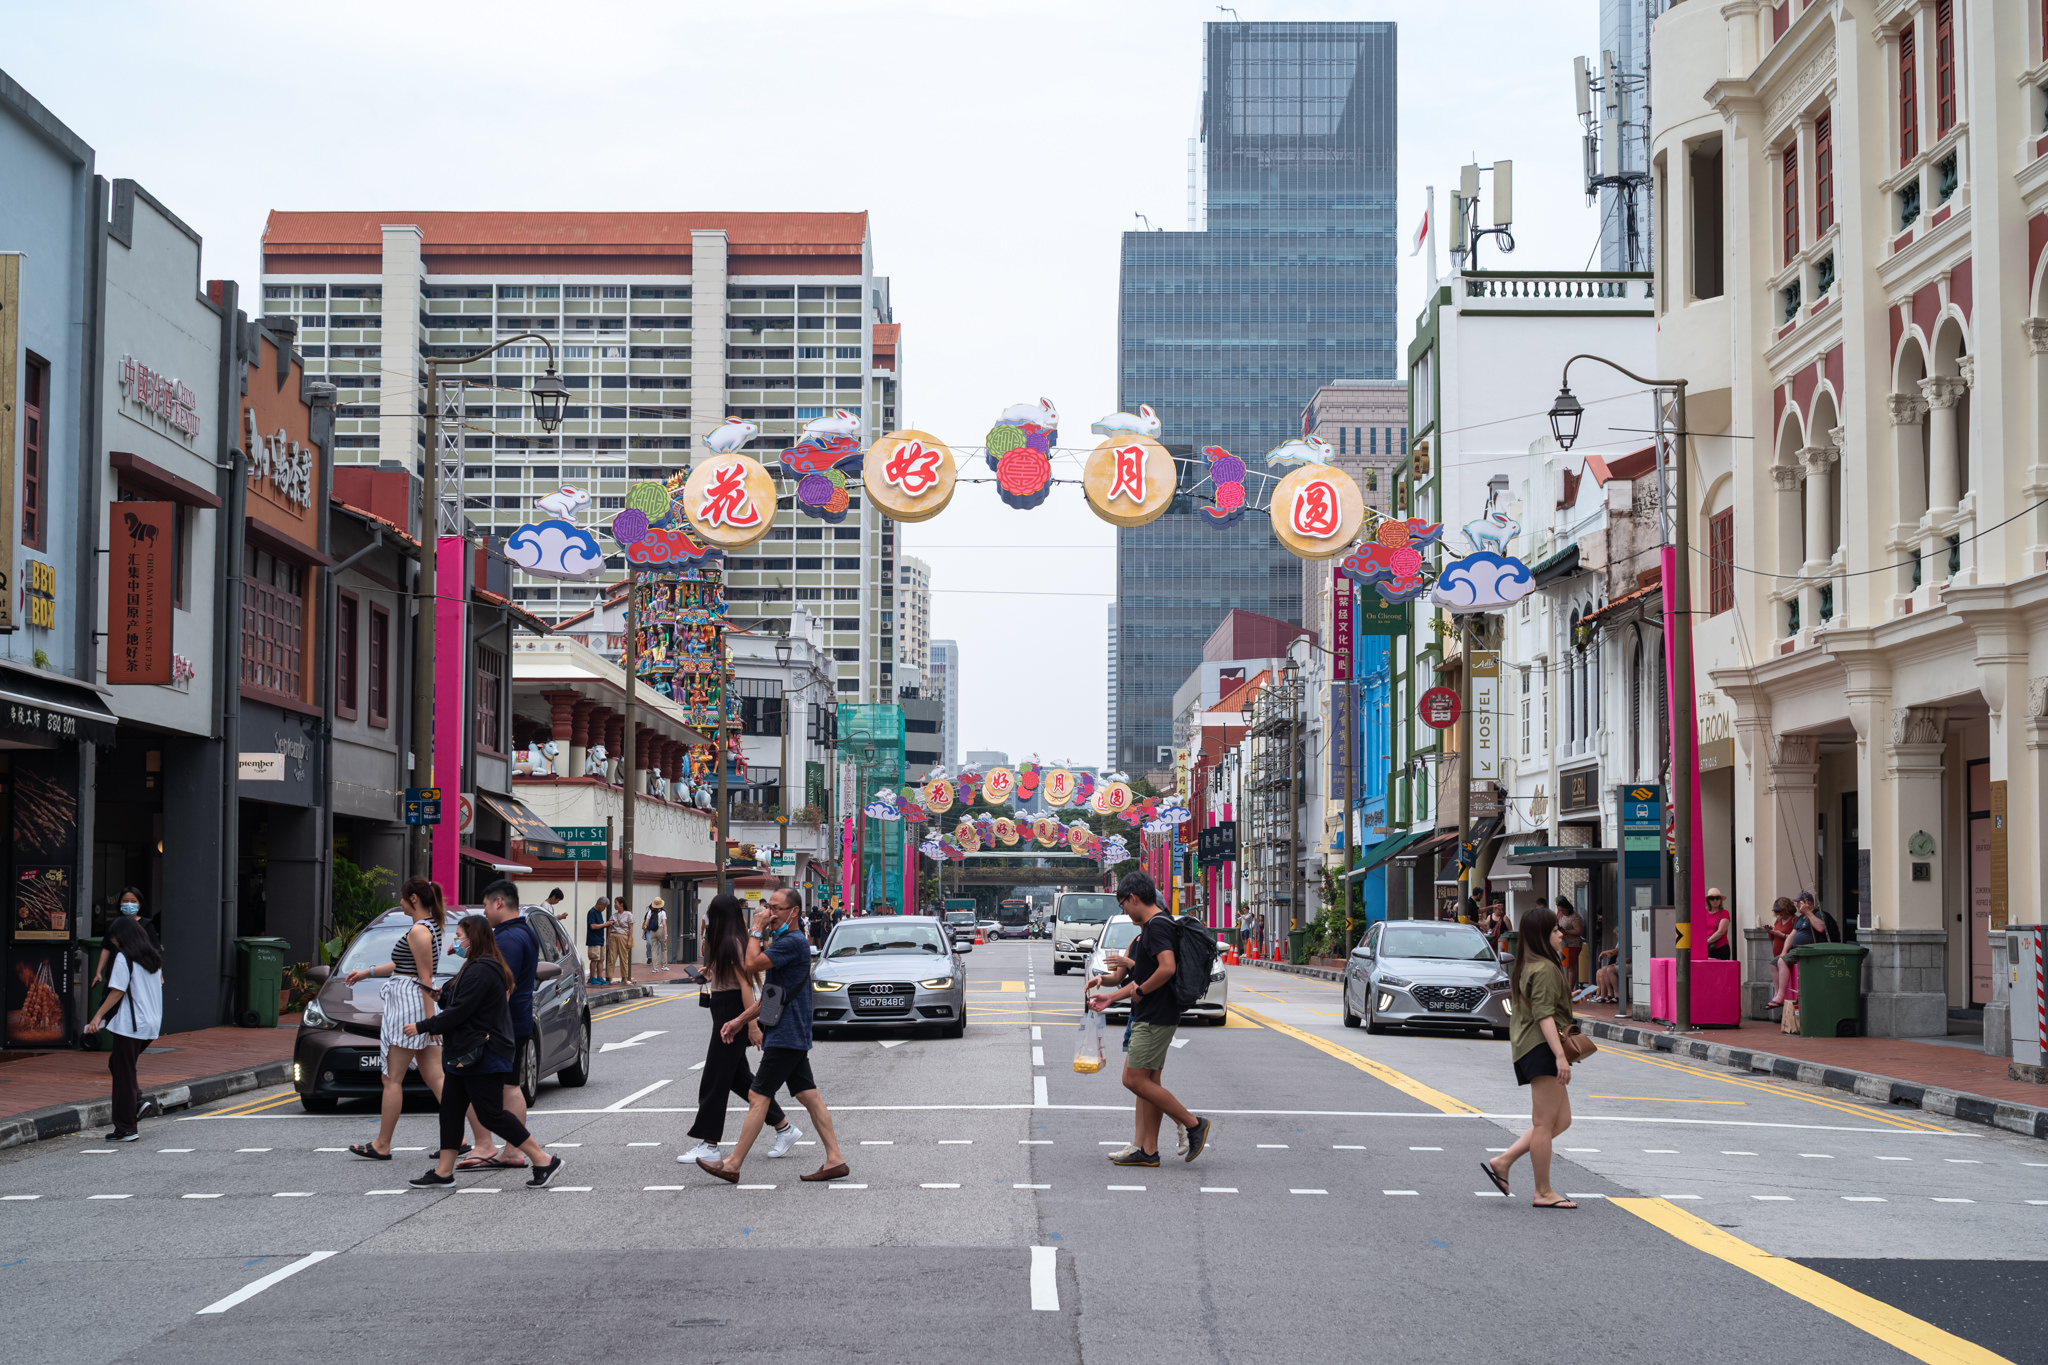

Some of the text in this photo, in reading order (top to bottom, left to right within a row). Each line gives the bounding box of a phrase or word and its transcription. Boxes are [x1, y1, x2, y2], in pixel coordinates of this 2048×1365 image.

[124, 356, 173, 420] 中國汾酒
[177, 379, 196, 409] CHINA
[175, 401, 201, 437] FENJIU
[700, 462, 760, 527] 花
[885, 441, 941, 495] 好
[1110, 446, 1147, 503] 月
[32, 560, 55, 600] BBQ
[146, 552, 154, 581] CHINA
[146, 582, 154, 607] BAMA
[32, 596, 55, 630] BOX
[126, 552, 140, 672] 汇集中国原产地好茶
[145, 608, 153, 626] TEA
[1377, 612, 1402, 621] Cheong
[145, 627, 153, 652] SINCE
[1428, 693, 1453, 723] 當
[1479, 689, 1490, 749] HOSTEL
[1706, 711, 1729, 744] ROOM
[239, 760, 275, 769] ptember
[930, 782, 949, 803] 花
[992, 771, 1010, 790] 好
[1053, 772, 1065, 793] 月
[557, 828, 603, 840] mple St
[567, 848, 591, 858] 婆街
[1829, 969, 1853, 978] SBR
